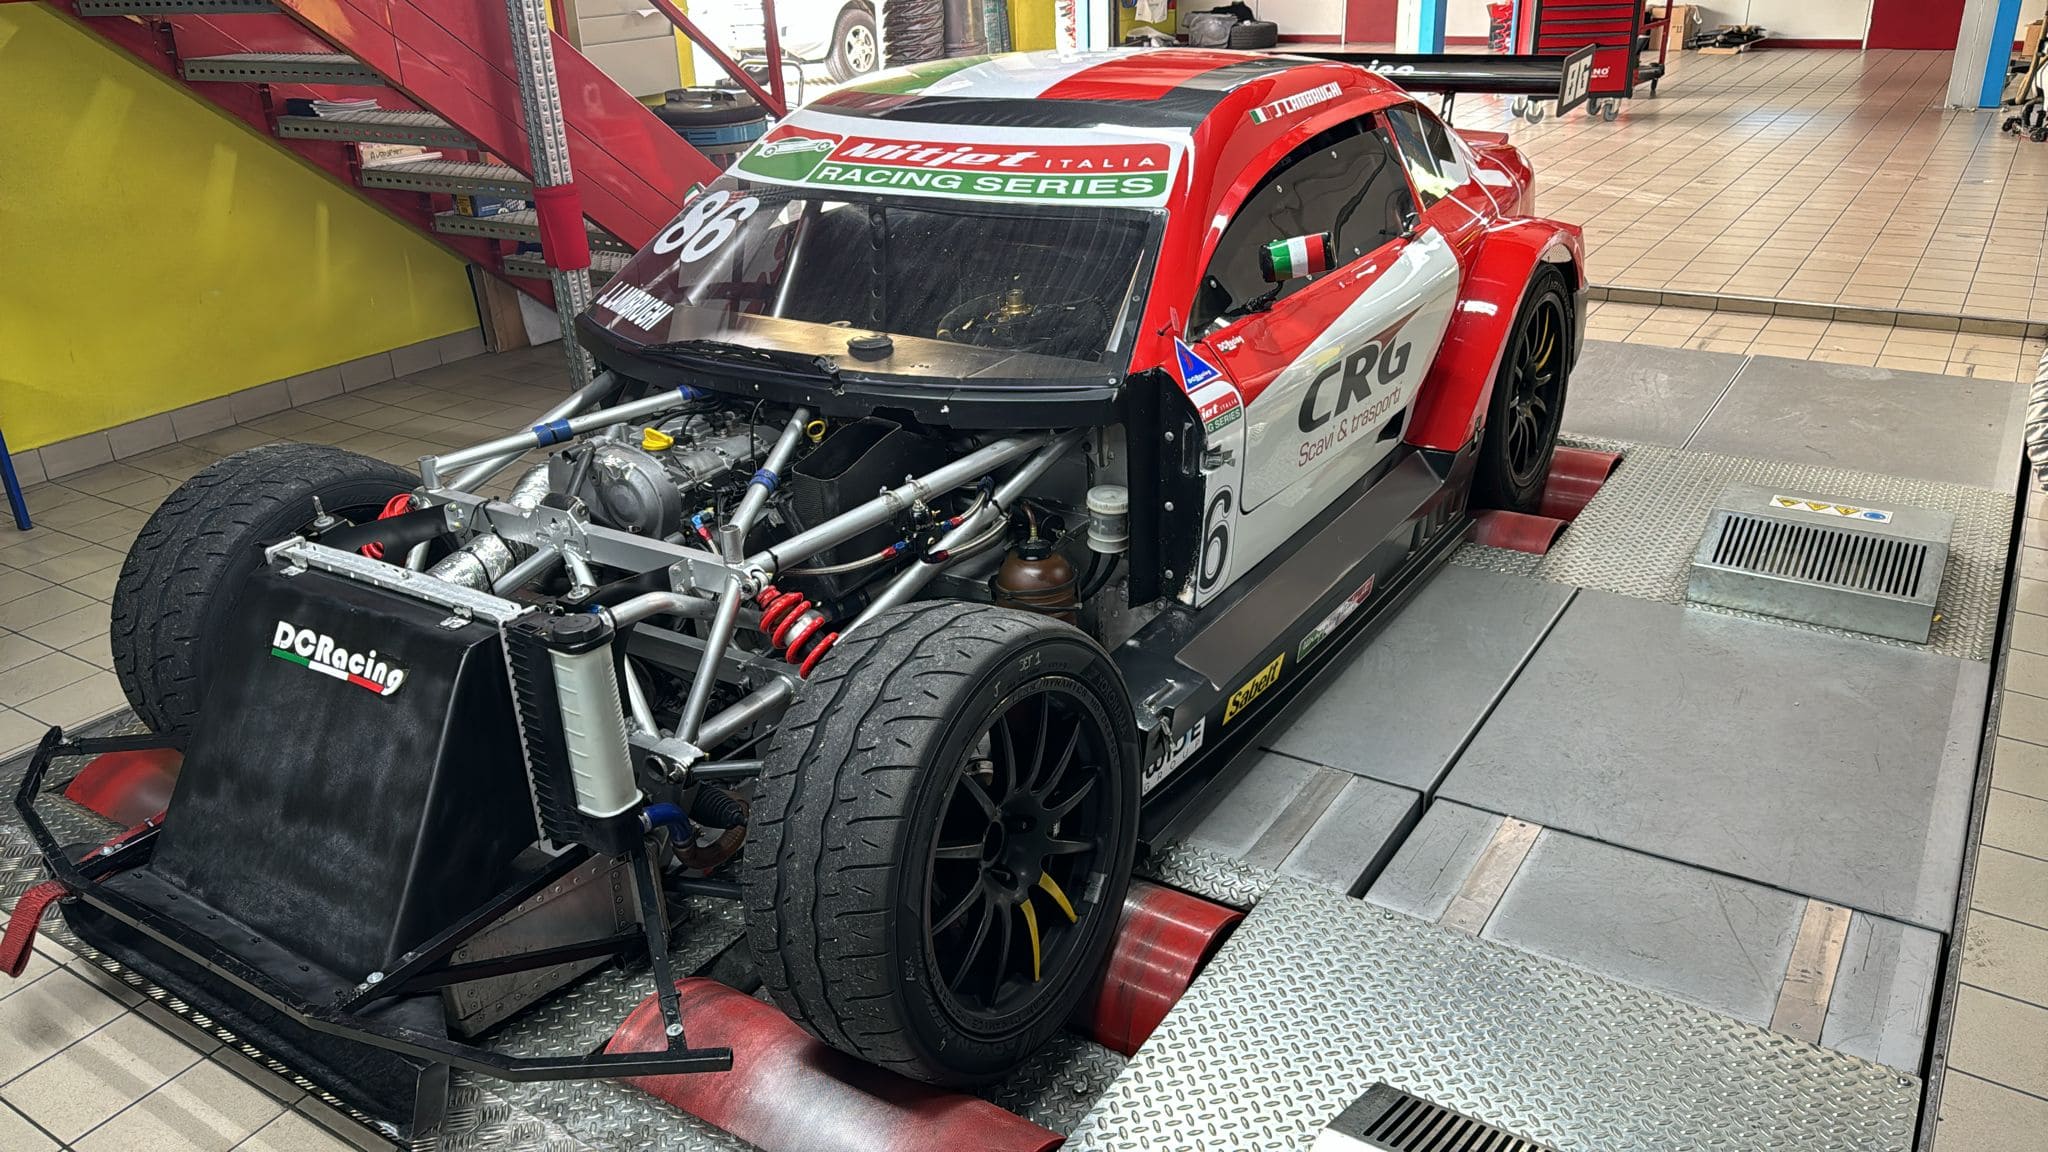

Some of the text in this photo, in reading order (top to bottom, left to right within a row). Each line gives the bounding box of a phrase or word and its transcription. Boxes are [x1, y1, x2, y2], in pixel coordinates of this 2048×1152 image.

[1562, 54, 1593, 107] 86
[815, 165, 1155, 196] RACING SERIES
[838, 142, 1157, 170] Mitjet ITALIA
[653, 189, 760, 264] 86
[1201, 403, 1219, 419] jet
[1298, 337, 1412, 433] CRG
[1215, 408, 1241, 429] SERIES
[1299, 381, 1403, 467] Scavi & trasporti
[272, 620, 404, 696] DCRacing
[1229, 661, 1279, 718] Sabelt
